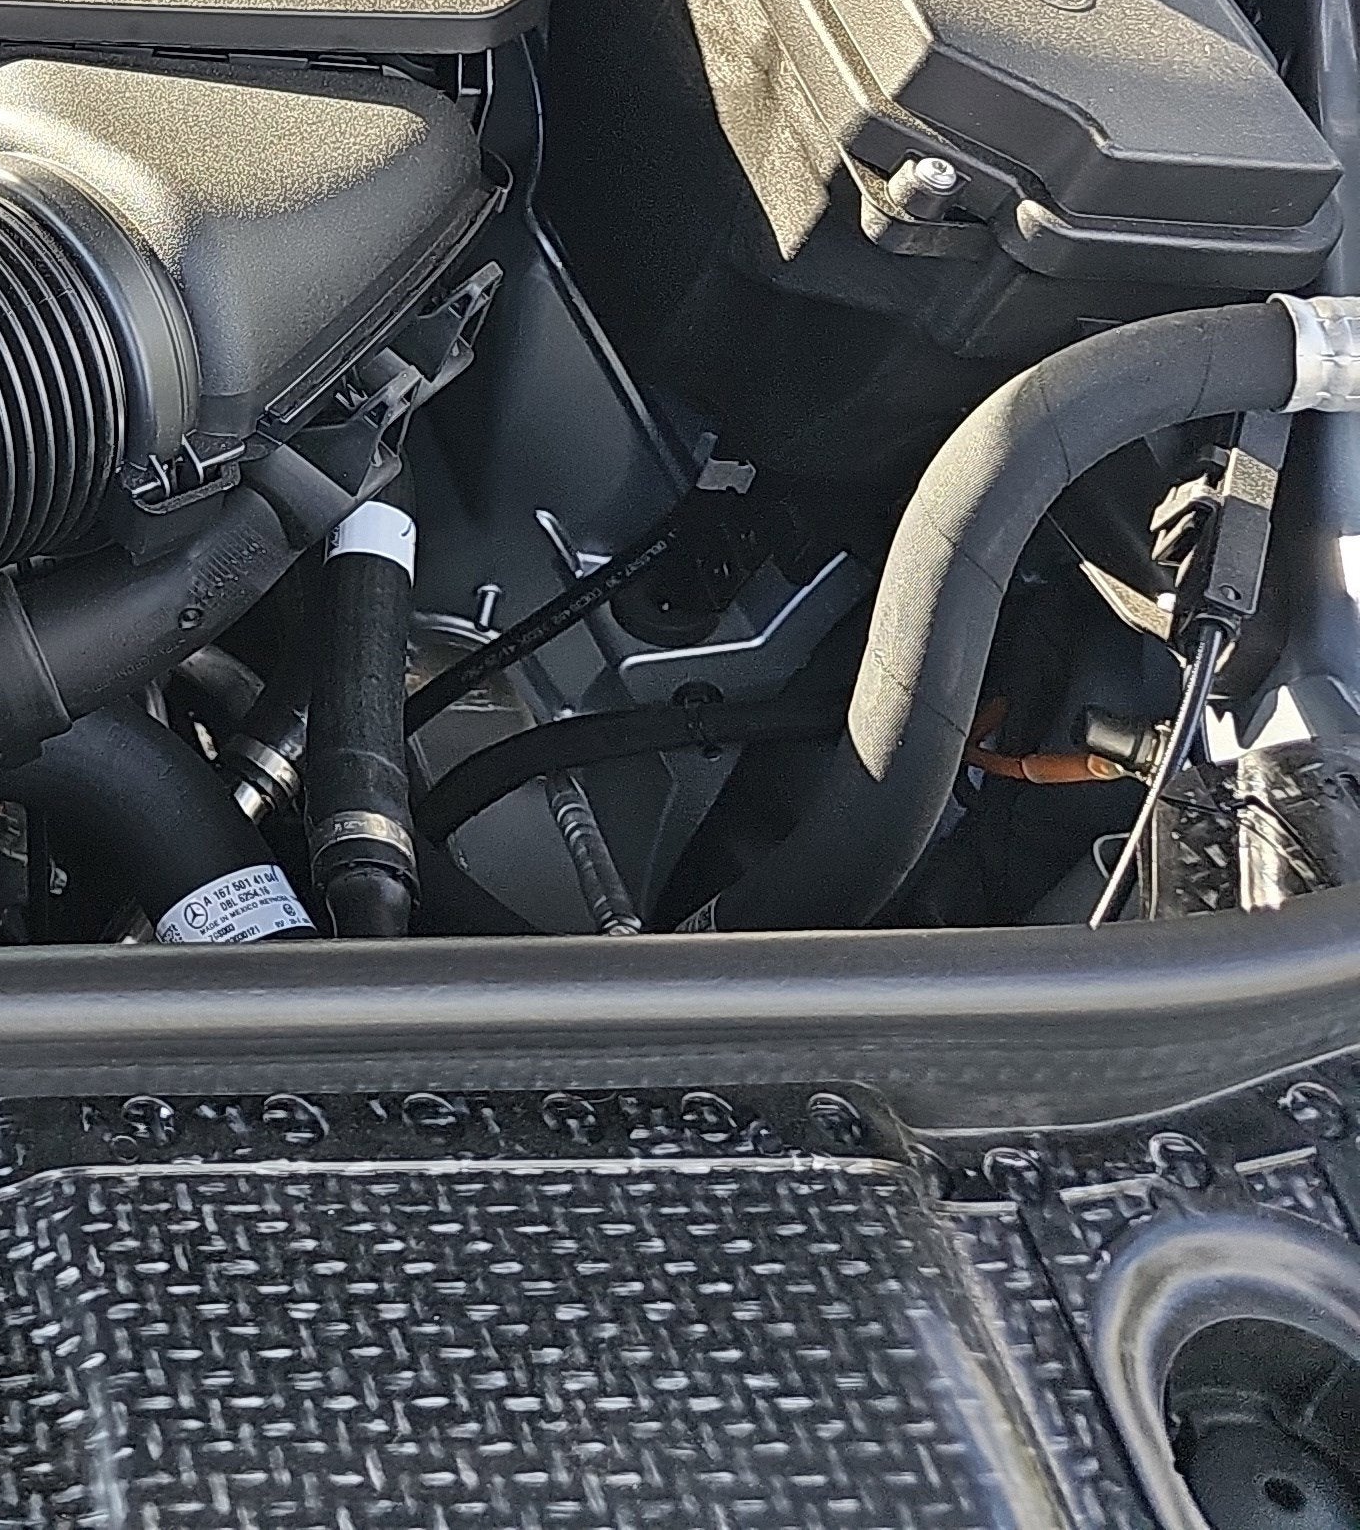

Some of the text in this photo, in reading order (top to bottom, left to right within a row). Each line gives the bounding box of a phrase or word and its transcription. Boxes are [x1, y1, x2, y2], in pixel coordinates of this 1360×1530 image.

[203, 896, 212, 907] A
[213, 885, 231, 900] 167
[232, 878, 252, 892] 501
[230, 901, 258, 918] MEXICO
